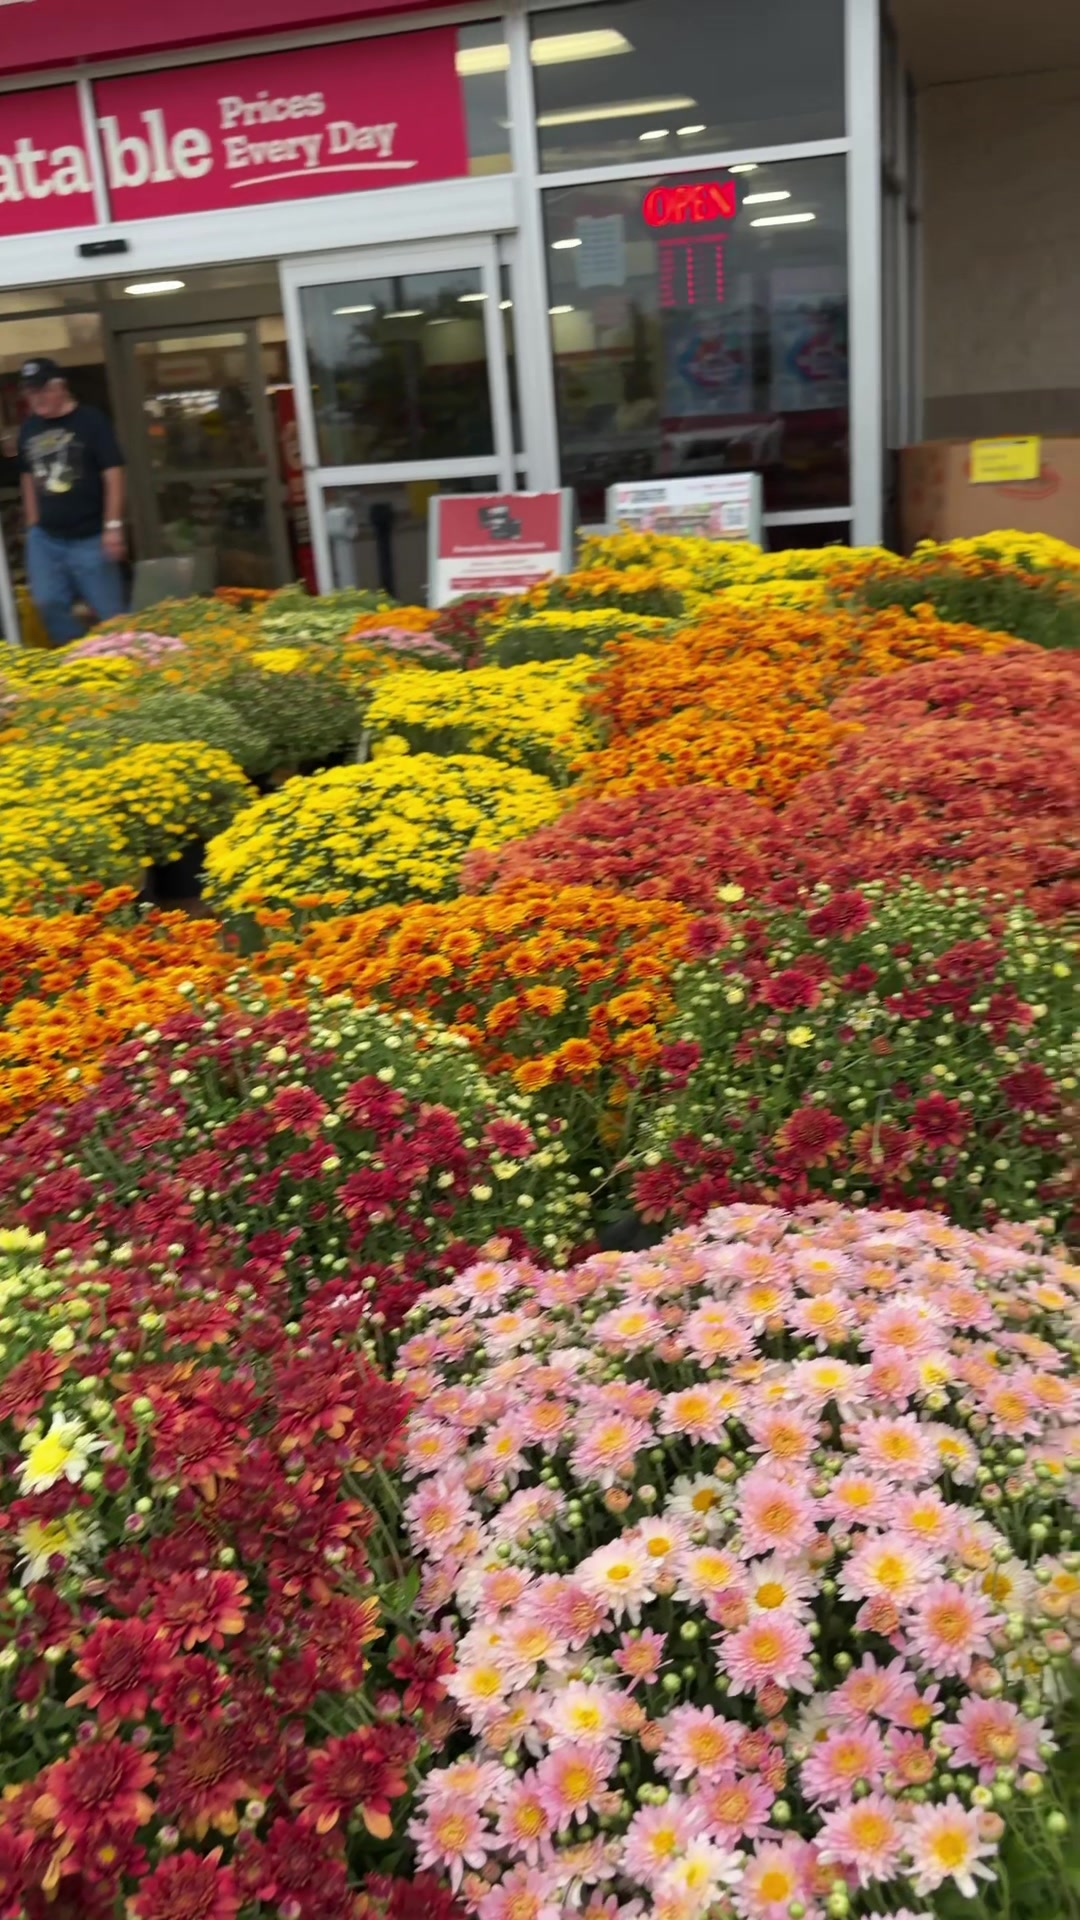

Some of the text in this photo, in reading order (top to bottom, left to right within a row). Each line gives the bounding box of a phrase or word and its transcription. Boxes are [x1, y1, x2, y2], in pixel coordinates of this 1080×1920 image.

[218, 90, 326, 129] Prices
[222, 121, 397, 169] Every Day
[643, 180, 736, 228] OPEN
